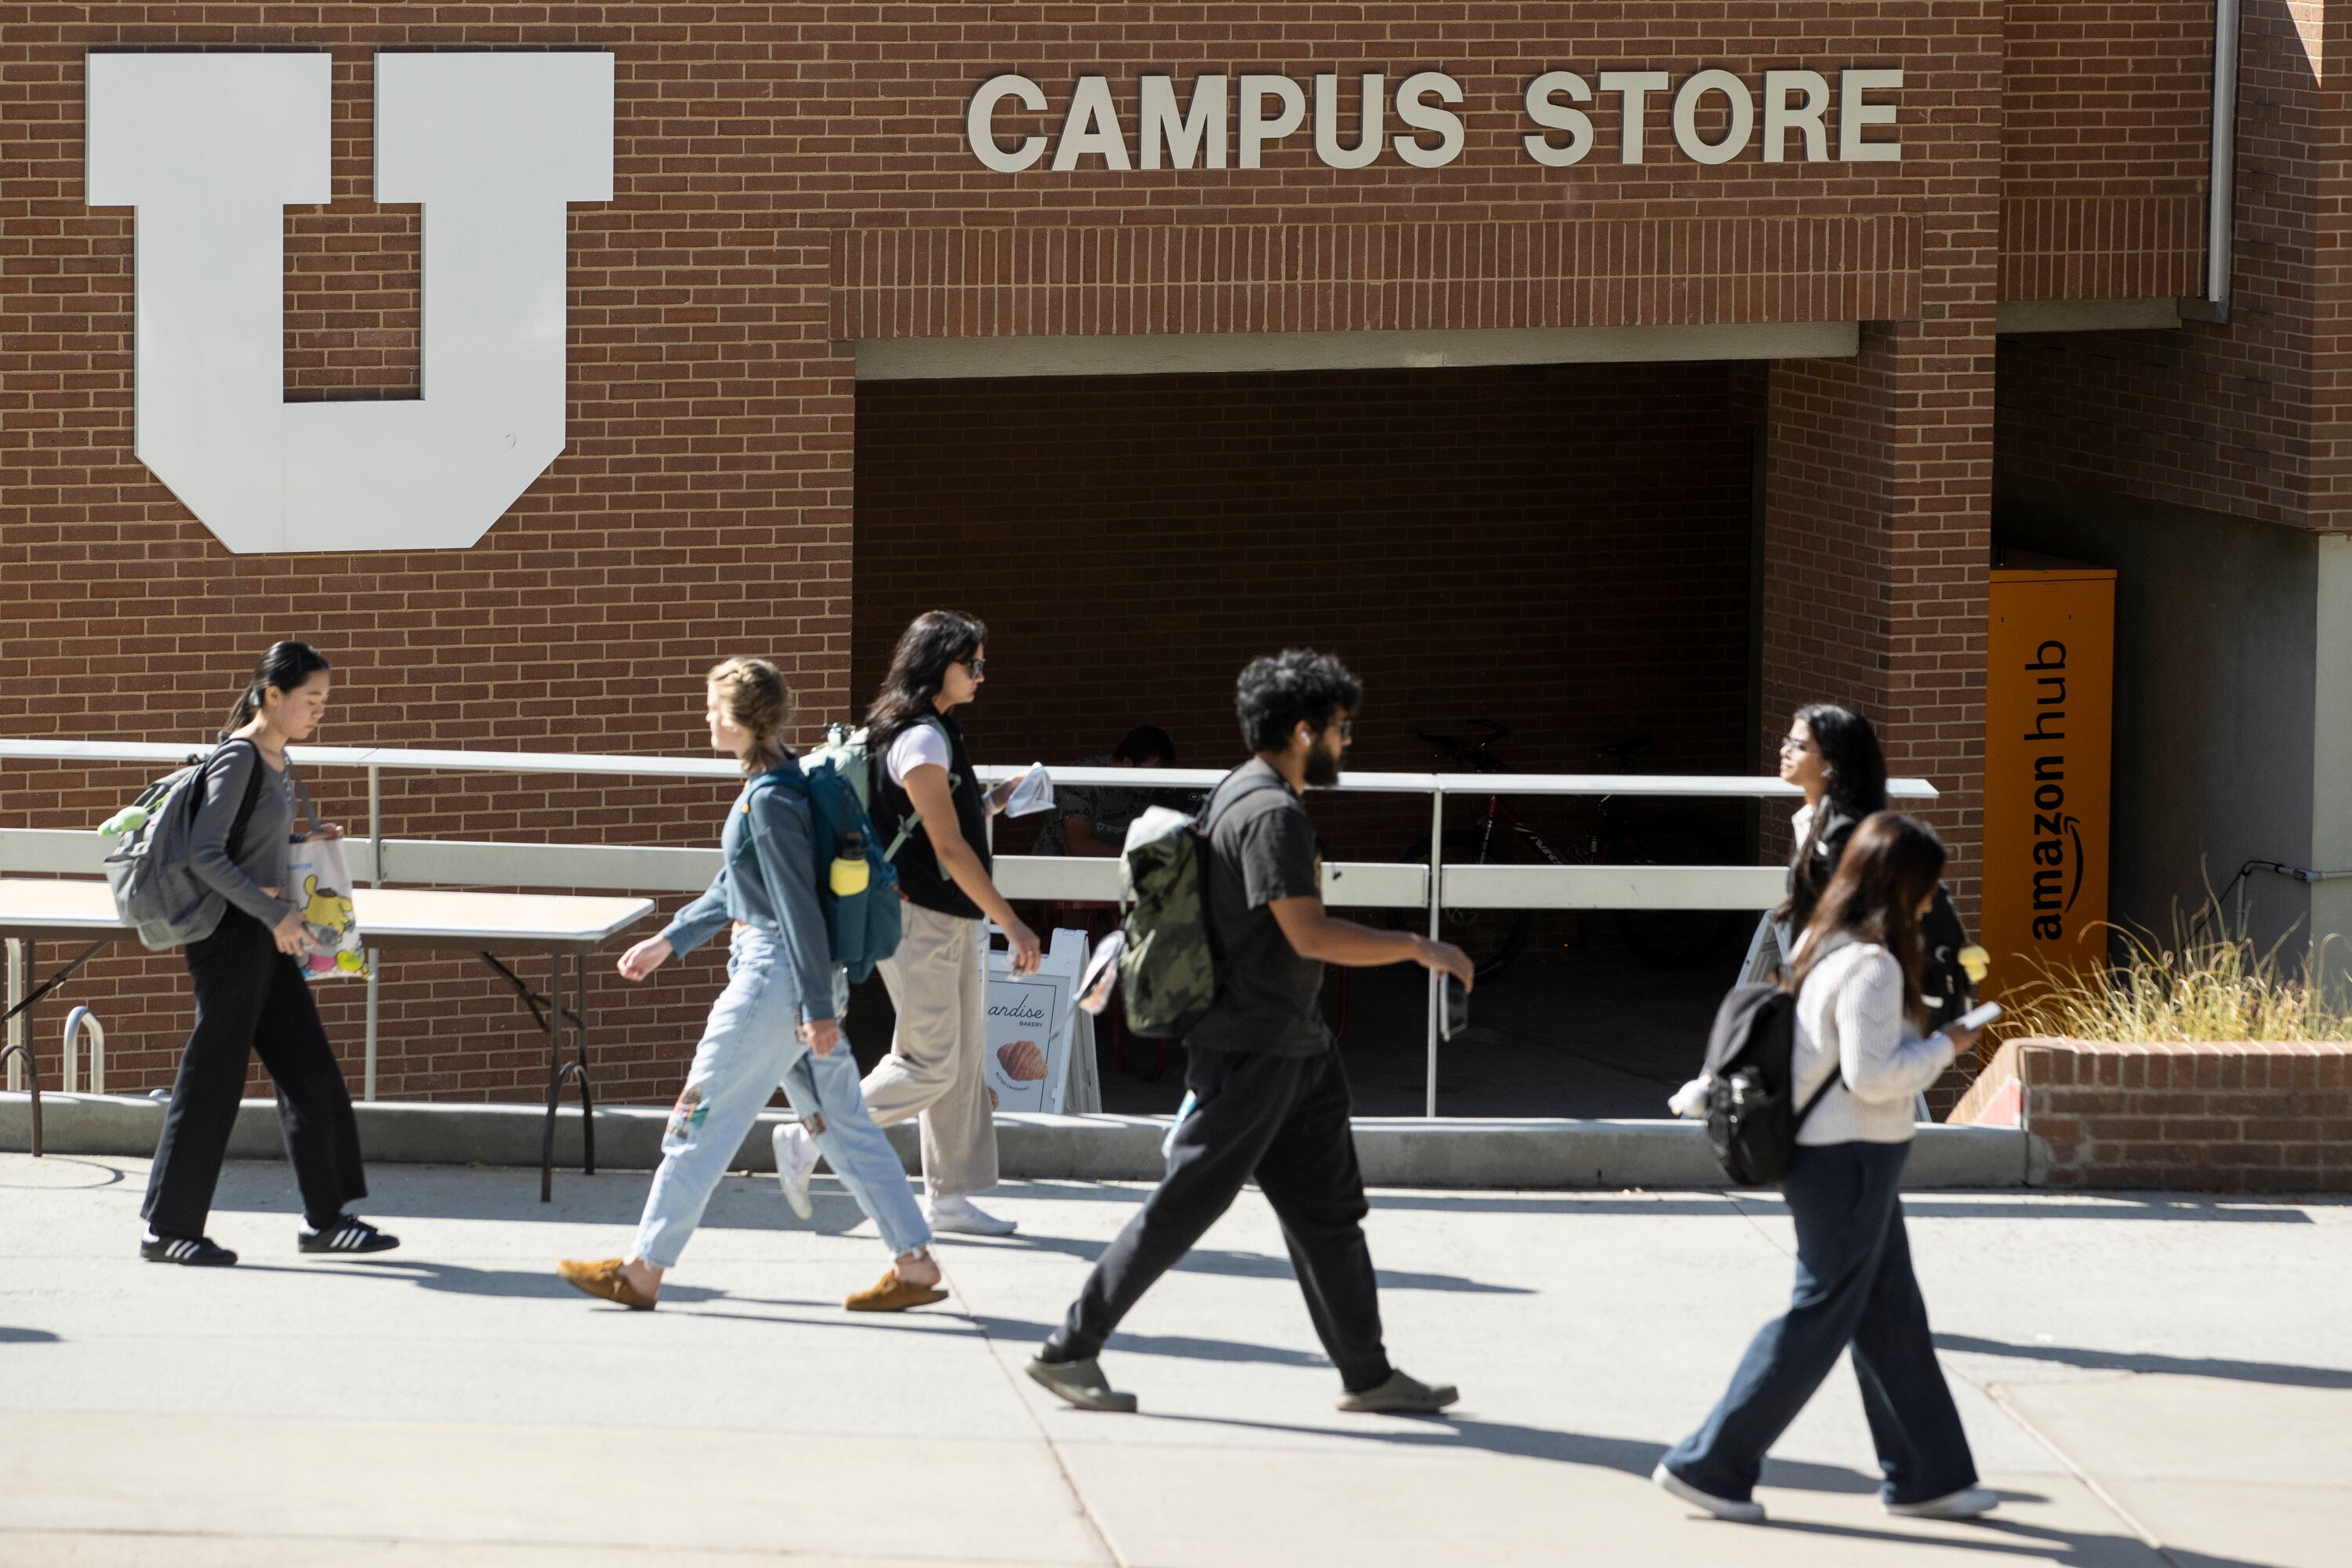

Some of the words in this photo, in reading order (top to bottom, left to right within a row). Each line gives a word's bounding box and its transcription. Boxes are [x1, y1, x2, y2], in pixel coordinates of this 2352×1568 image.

[967, 71, 1465, 174] CAMPUS
[1522, 68, 1904, 168] STORE
[85, 52, 615, 554] U
[2024, 640, 2067, 740] hub
[2032, 756, 2064, 941] amazon
[988, 993, 1044, 1018] andise
